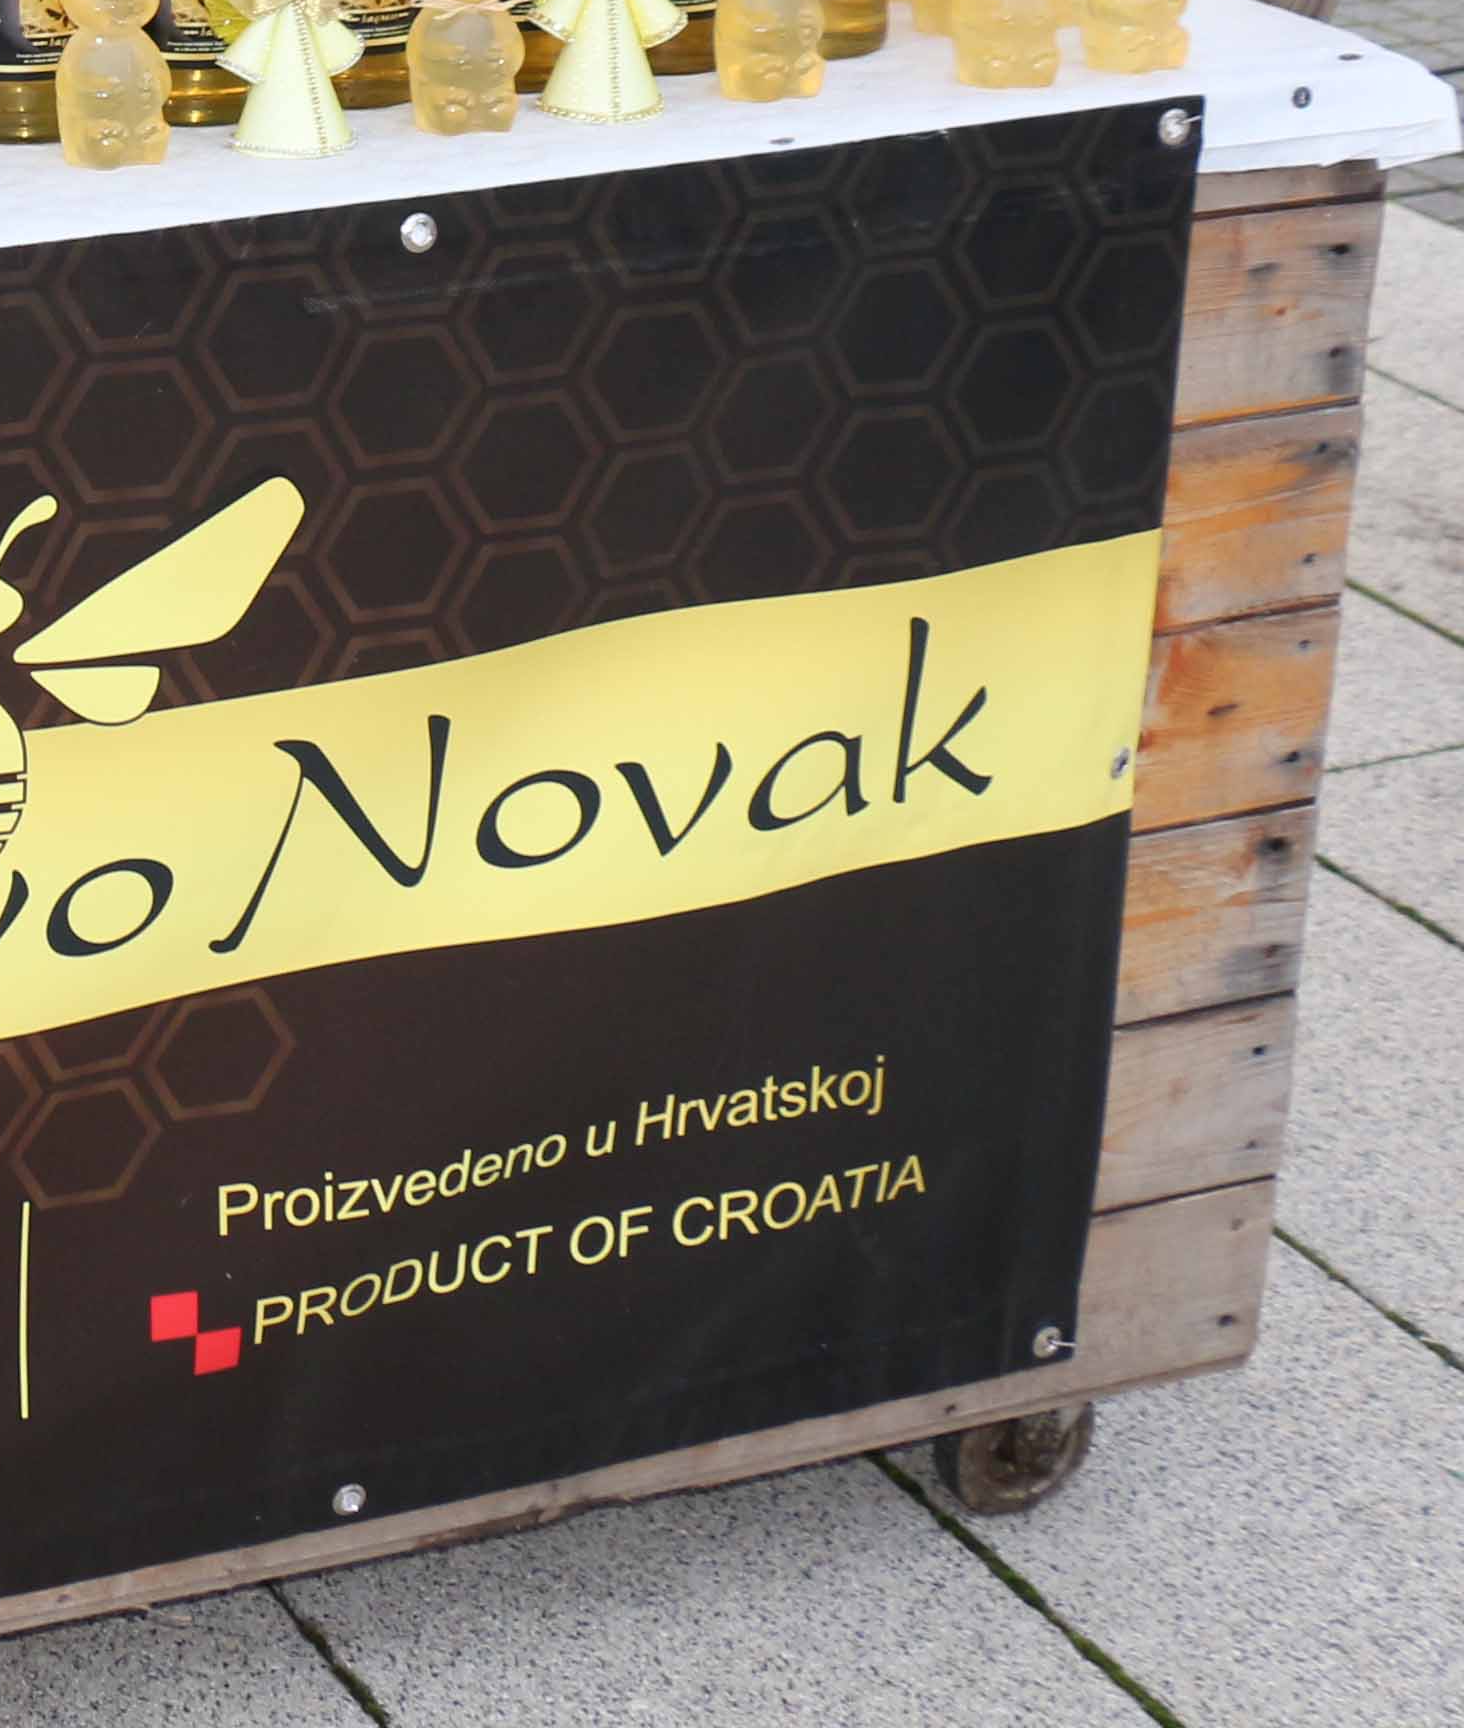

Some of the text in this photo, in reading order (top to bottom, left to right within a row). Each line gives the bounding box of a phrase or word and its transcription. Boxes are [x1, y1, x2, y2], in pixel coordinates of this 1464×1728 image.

[208, 616, 993, 956] Novak
[217, 1054, 887, 1237] Proizvedeno u Hrvatskoj
[252, 1153, 928, 1346] PRODUCT OF CROATIA
